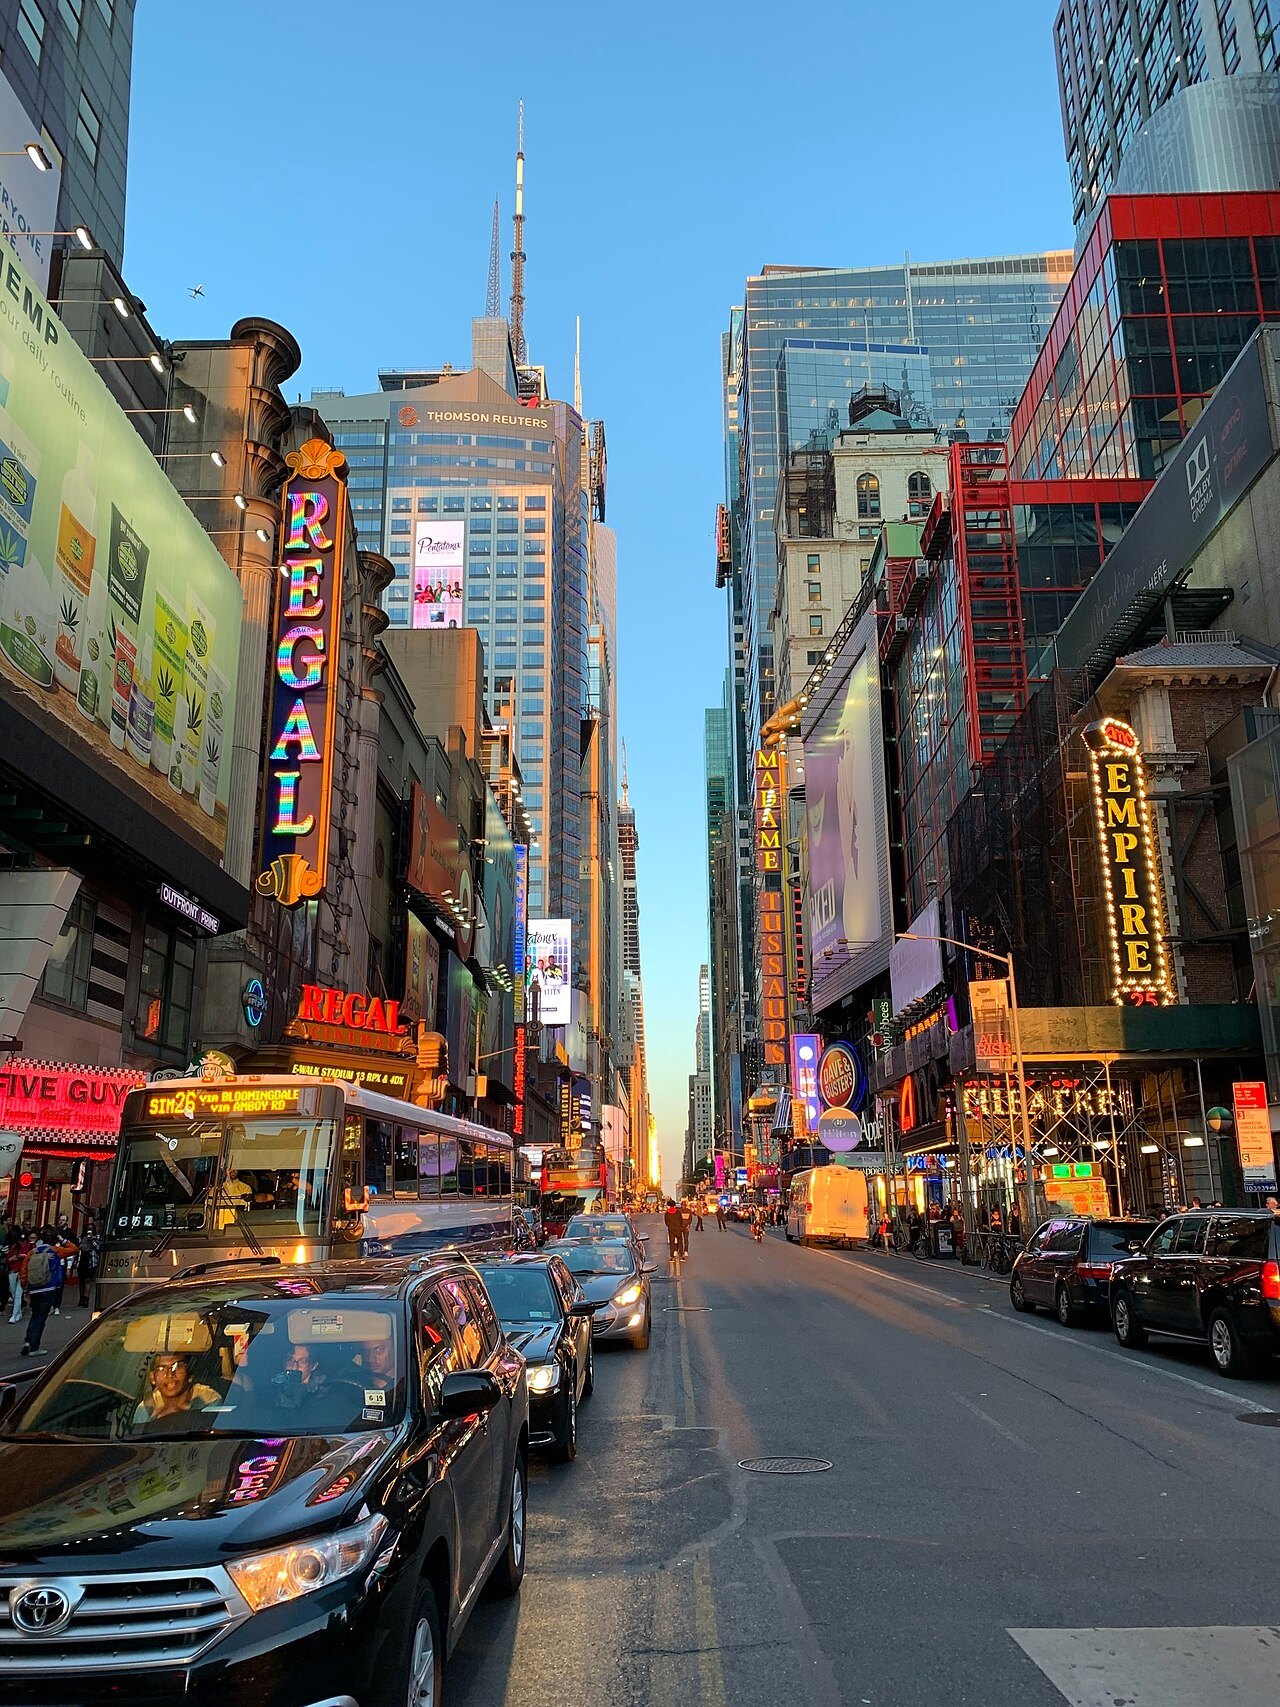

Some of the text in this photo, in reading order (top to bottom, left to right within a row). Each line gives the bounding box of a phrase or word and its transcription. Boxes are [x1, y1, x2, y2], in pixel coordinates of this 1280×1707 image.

[0, 182, 44, 264] RYONE,
[0, 249, 59, 345] EMP
[22, 330, 48, 372] daily
[50, 368, 88, 426] routine.
[427, 411, 548, 429] THOMSON REUTERS
[1190, 473, 1212, 511] DOLBY
[1191, 488, 1214, 523] CINEMA
[417, 536, 463, 554] Pentatonix
[1148, 558, 1168, 590] HERE
[269, 491, 333, 836] REGAL
[1105, 726, 1133, 747] amc
[757, 750, 780, 870] MADAME
[1104, 763, 1151, 972] EMPIRE
[162, 886, 218, 932] OUTFRONT PRIME
[298, 984, 406, 1034] REGAL
[1130, 992, 1159, 1006] 25
[310, 1025, 396, 1051] CINEMAS
[977, 1043, 1012, 1056] RISE
[980, 1033, 1005, 1044] ALL
[292, 1064, 405, 1085] E-WALK STADIUM 13 RPX & 4DX
[823, 1056, 851, 1084] DAVE &
[68, 1079, 134, 1106] GUY
[221, 1089, 300, 1102] BLOOMINGDALE
[825, 1070, 853, 1100] BUSTER'S
[149, 1091, 197, 1116] SIM26
[232, 1100, 269, 1112] AMBOY
[270, 1099, 286, 1111] RD
[561, 1083, 569, 1118] VICTORY
[823, 1128, 857, 1139] Hilton
[109, 1257, 130, 1269] 4305
